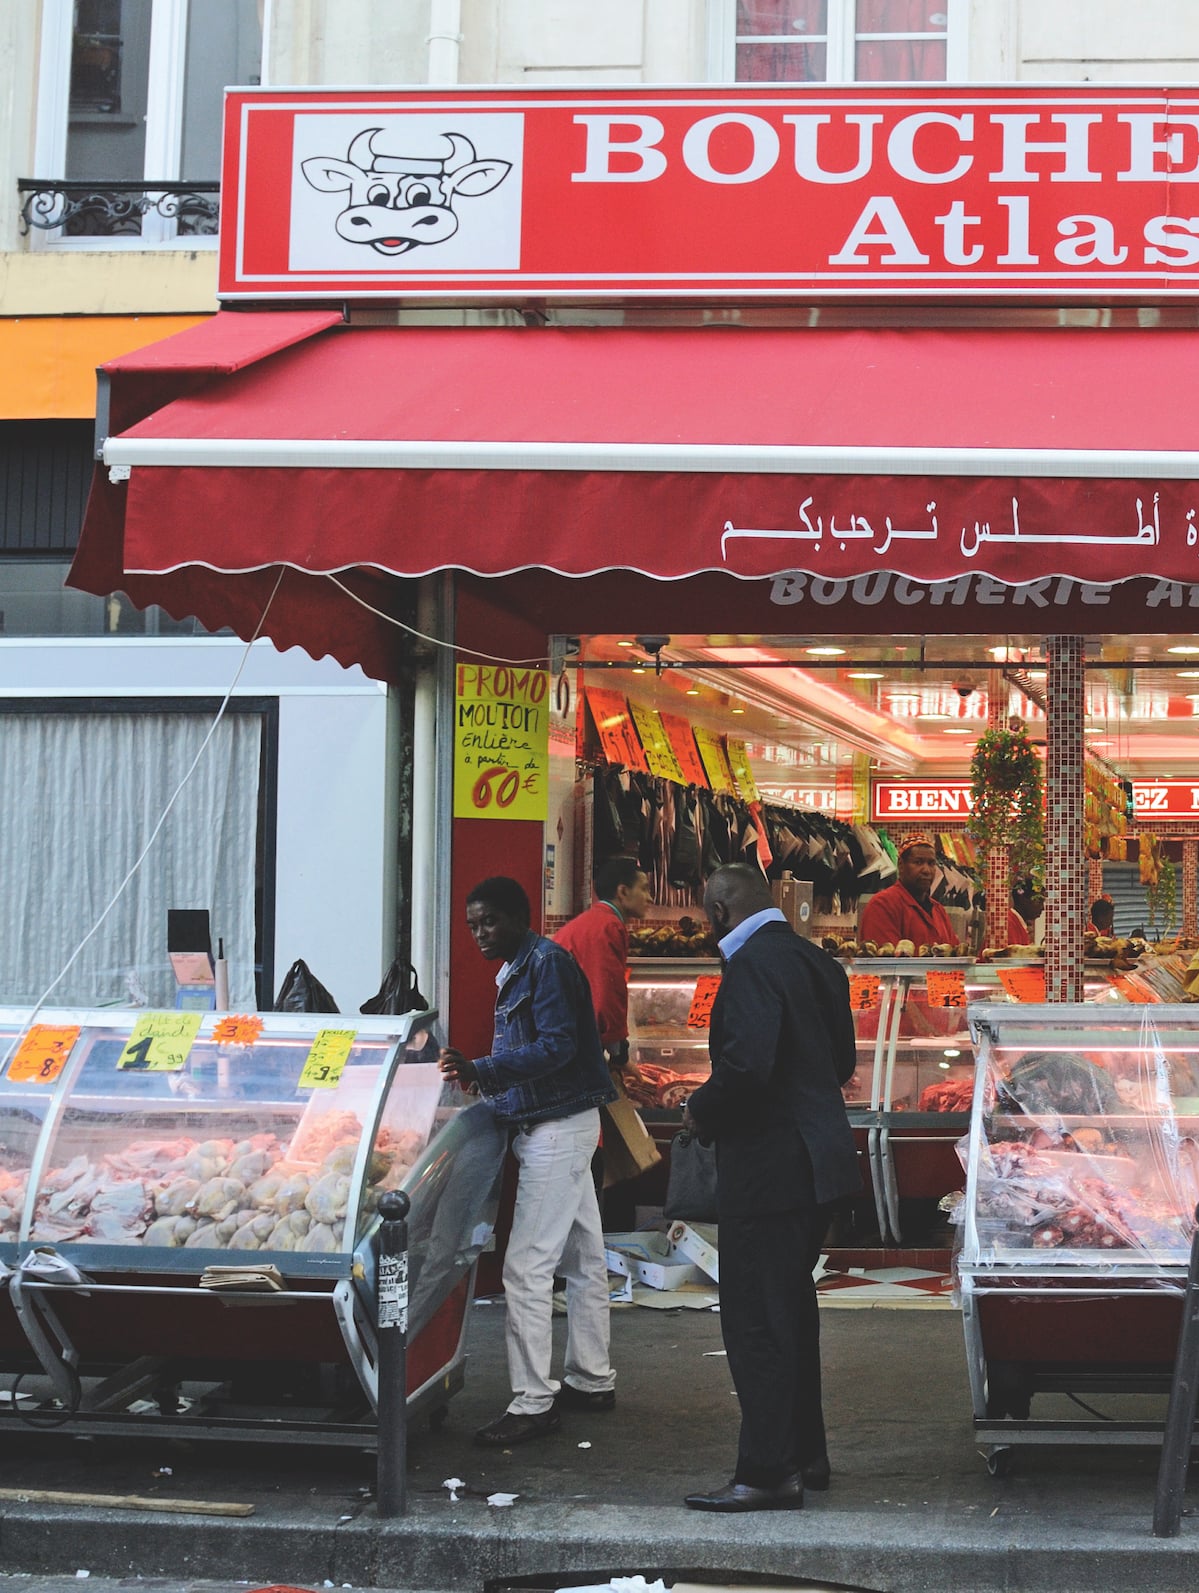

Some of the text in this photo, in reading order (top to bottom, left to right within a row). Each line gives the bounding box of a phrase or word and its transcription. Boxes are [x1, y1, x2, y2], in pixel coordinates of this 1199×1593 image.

[960, 492, 1160, 557] أطلس
[769, 571, 1113, 607] BOUCHERIE
[457, 665, 547, 703] PROMO
